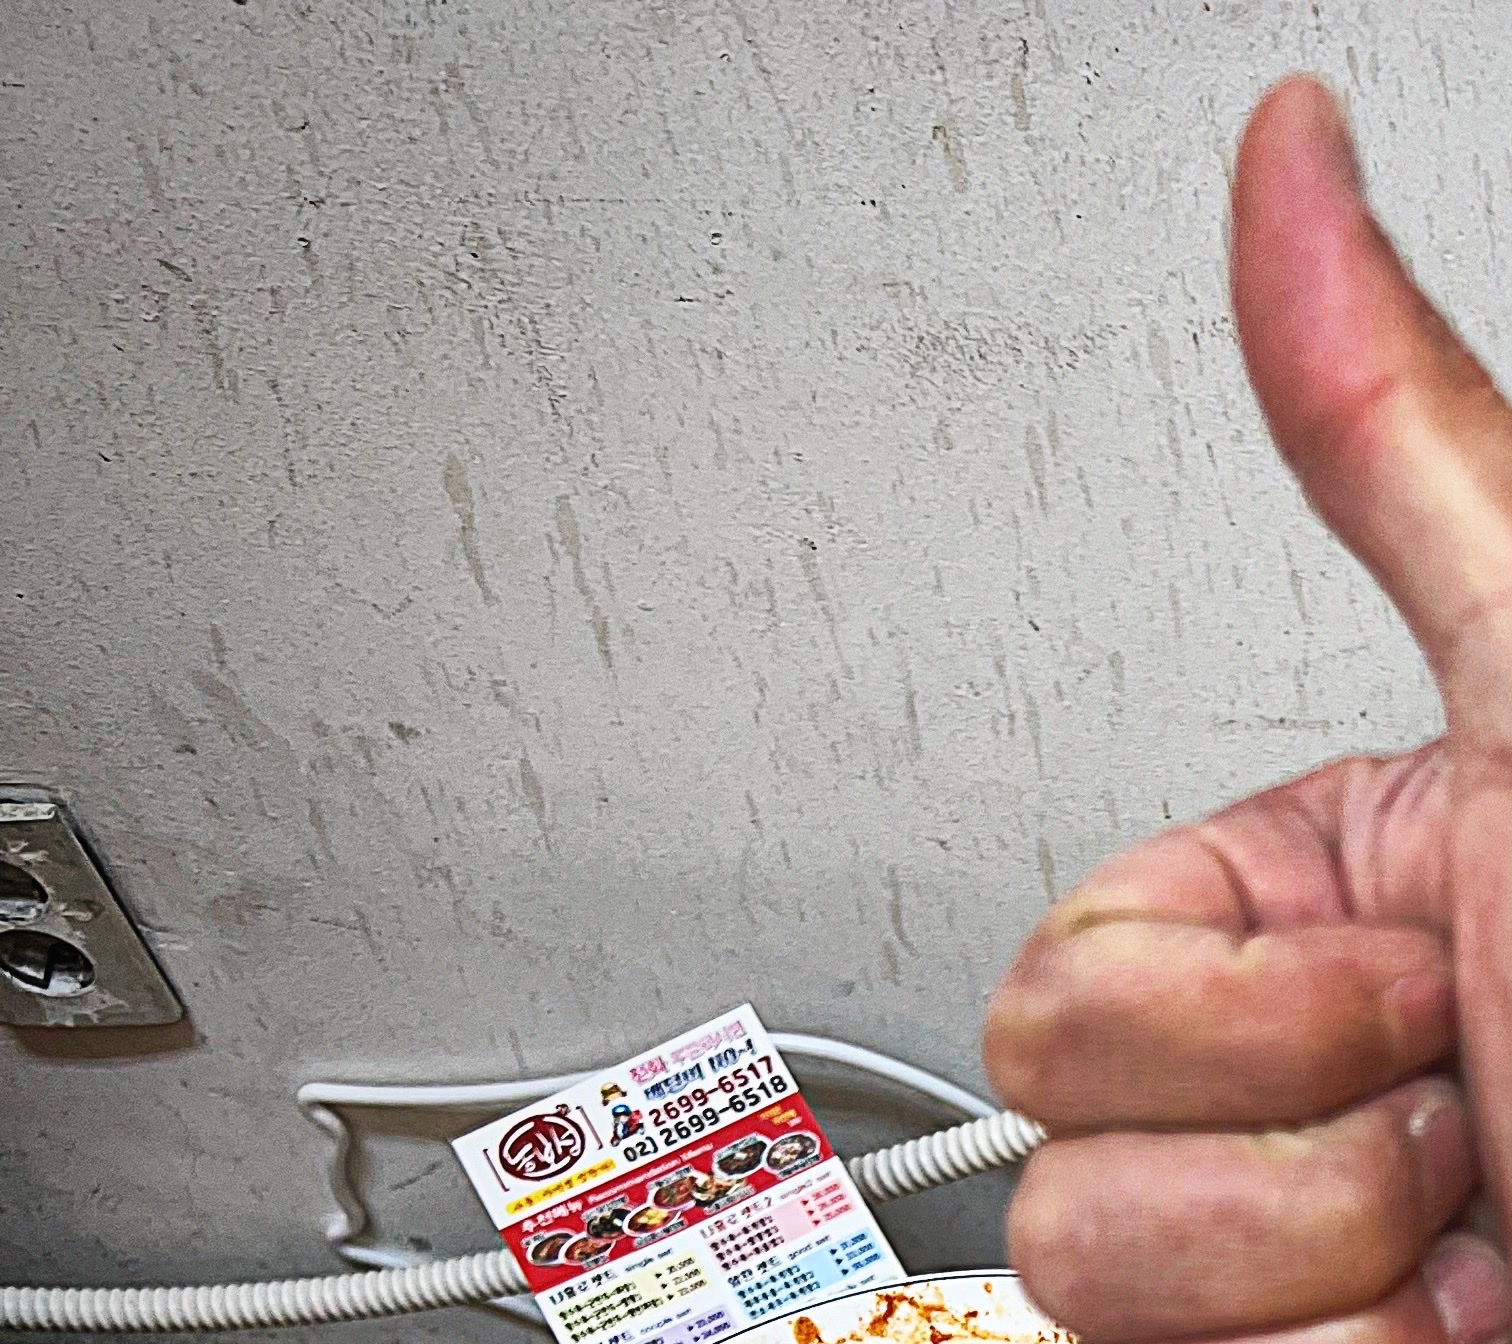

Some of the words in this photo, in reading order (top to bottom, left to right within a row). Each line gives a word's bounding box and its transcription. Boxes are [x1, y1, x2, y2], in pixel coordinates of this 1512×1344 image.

[622, 1136, 658, 1163] 02)
[658, 1074, 788, 1145] 2699-6518
[648, 1055, 777, 1127] 2699-6517
